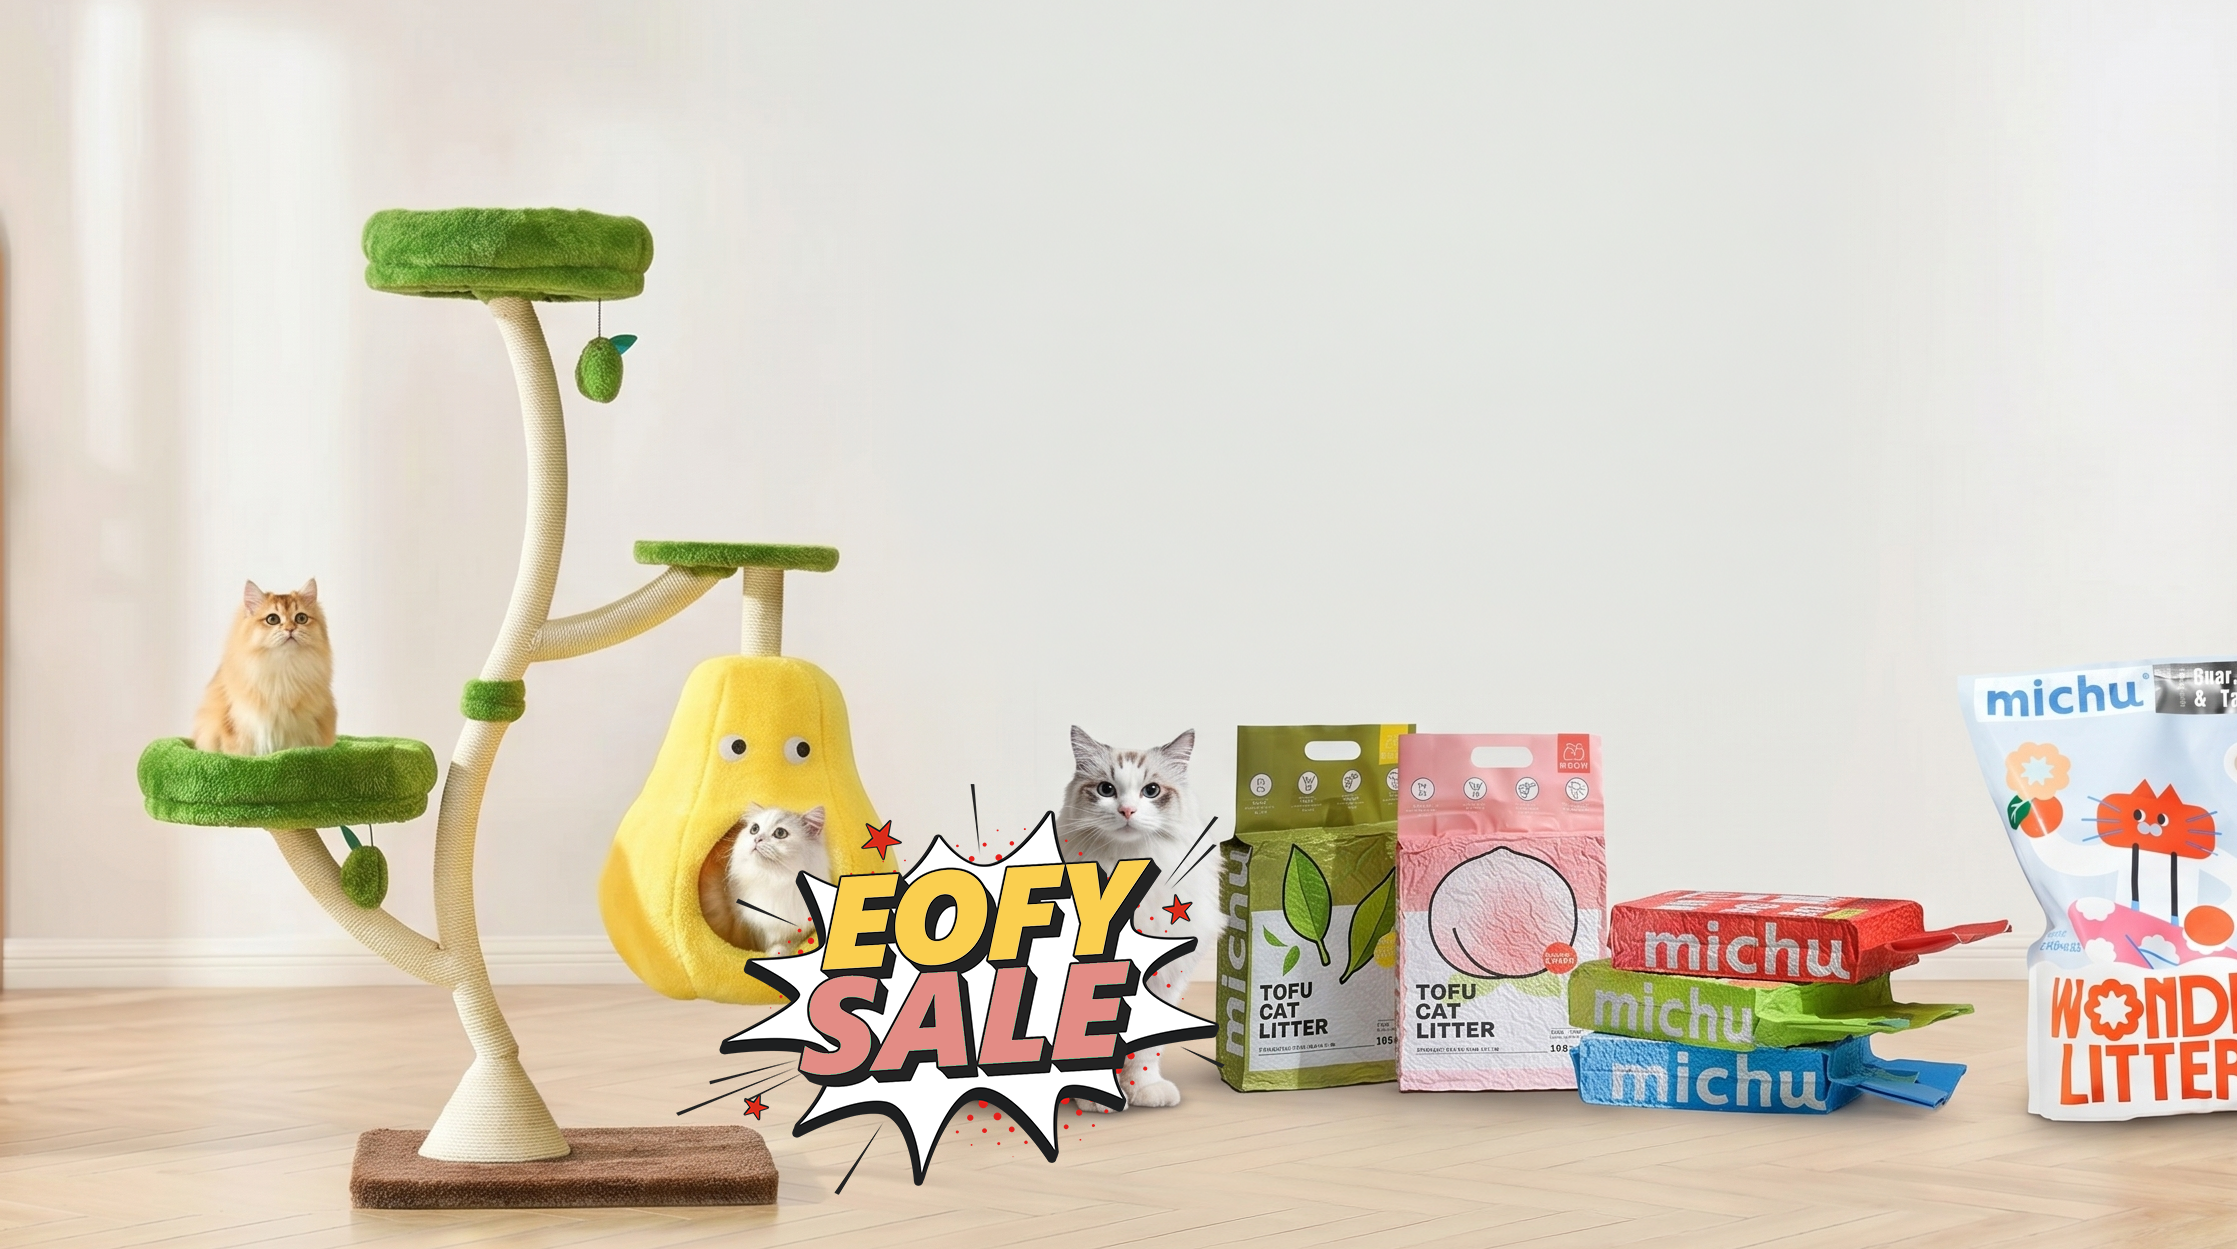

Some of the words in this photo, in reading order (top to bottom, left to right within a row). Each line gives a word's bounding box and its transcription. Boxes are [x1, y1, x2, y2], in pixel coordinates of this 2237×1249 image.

[1987, 675, 2144, 717] michu
[2194, 689, 2207, 707] &
[1222, 848, 1252, 1058] michu
[1644, 920, 1851, 980] michu
[1259, 981, 1313, 1001] TOFU
[1416, 984, 1477, 1001] TOFU
[1259, 1001, 1300, 1021] CAT
[1415, 1002, 1461, 1020] CAT
[1593, 982, 1755, 1044] michu
[2050, 973, 2237, 1042] WOND
[1259, 1018, 1329, 1039] LITTER
[1416, 1021, 1496, 1039] LITTER
[1611, 1051, 1828, 1111] michu
[2059, 1039, 2237, 1106] LITTER
